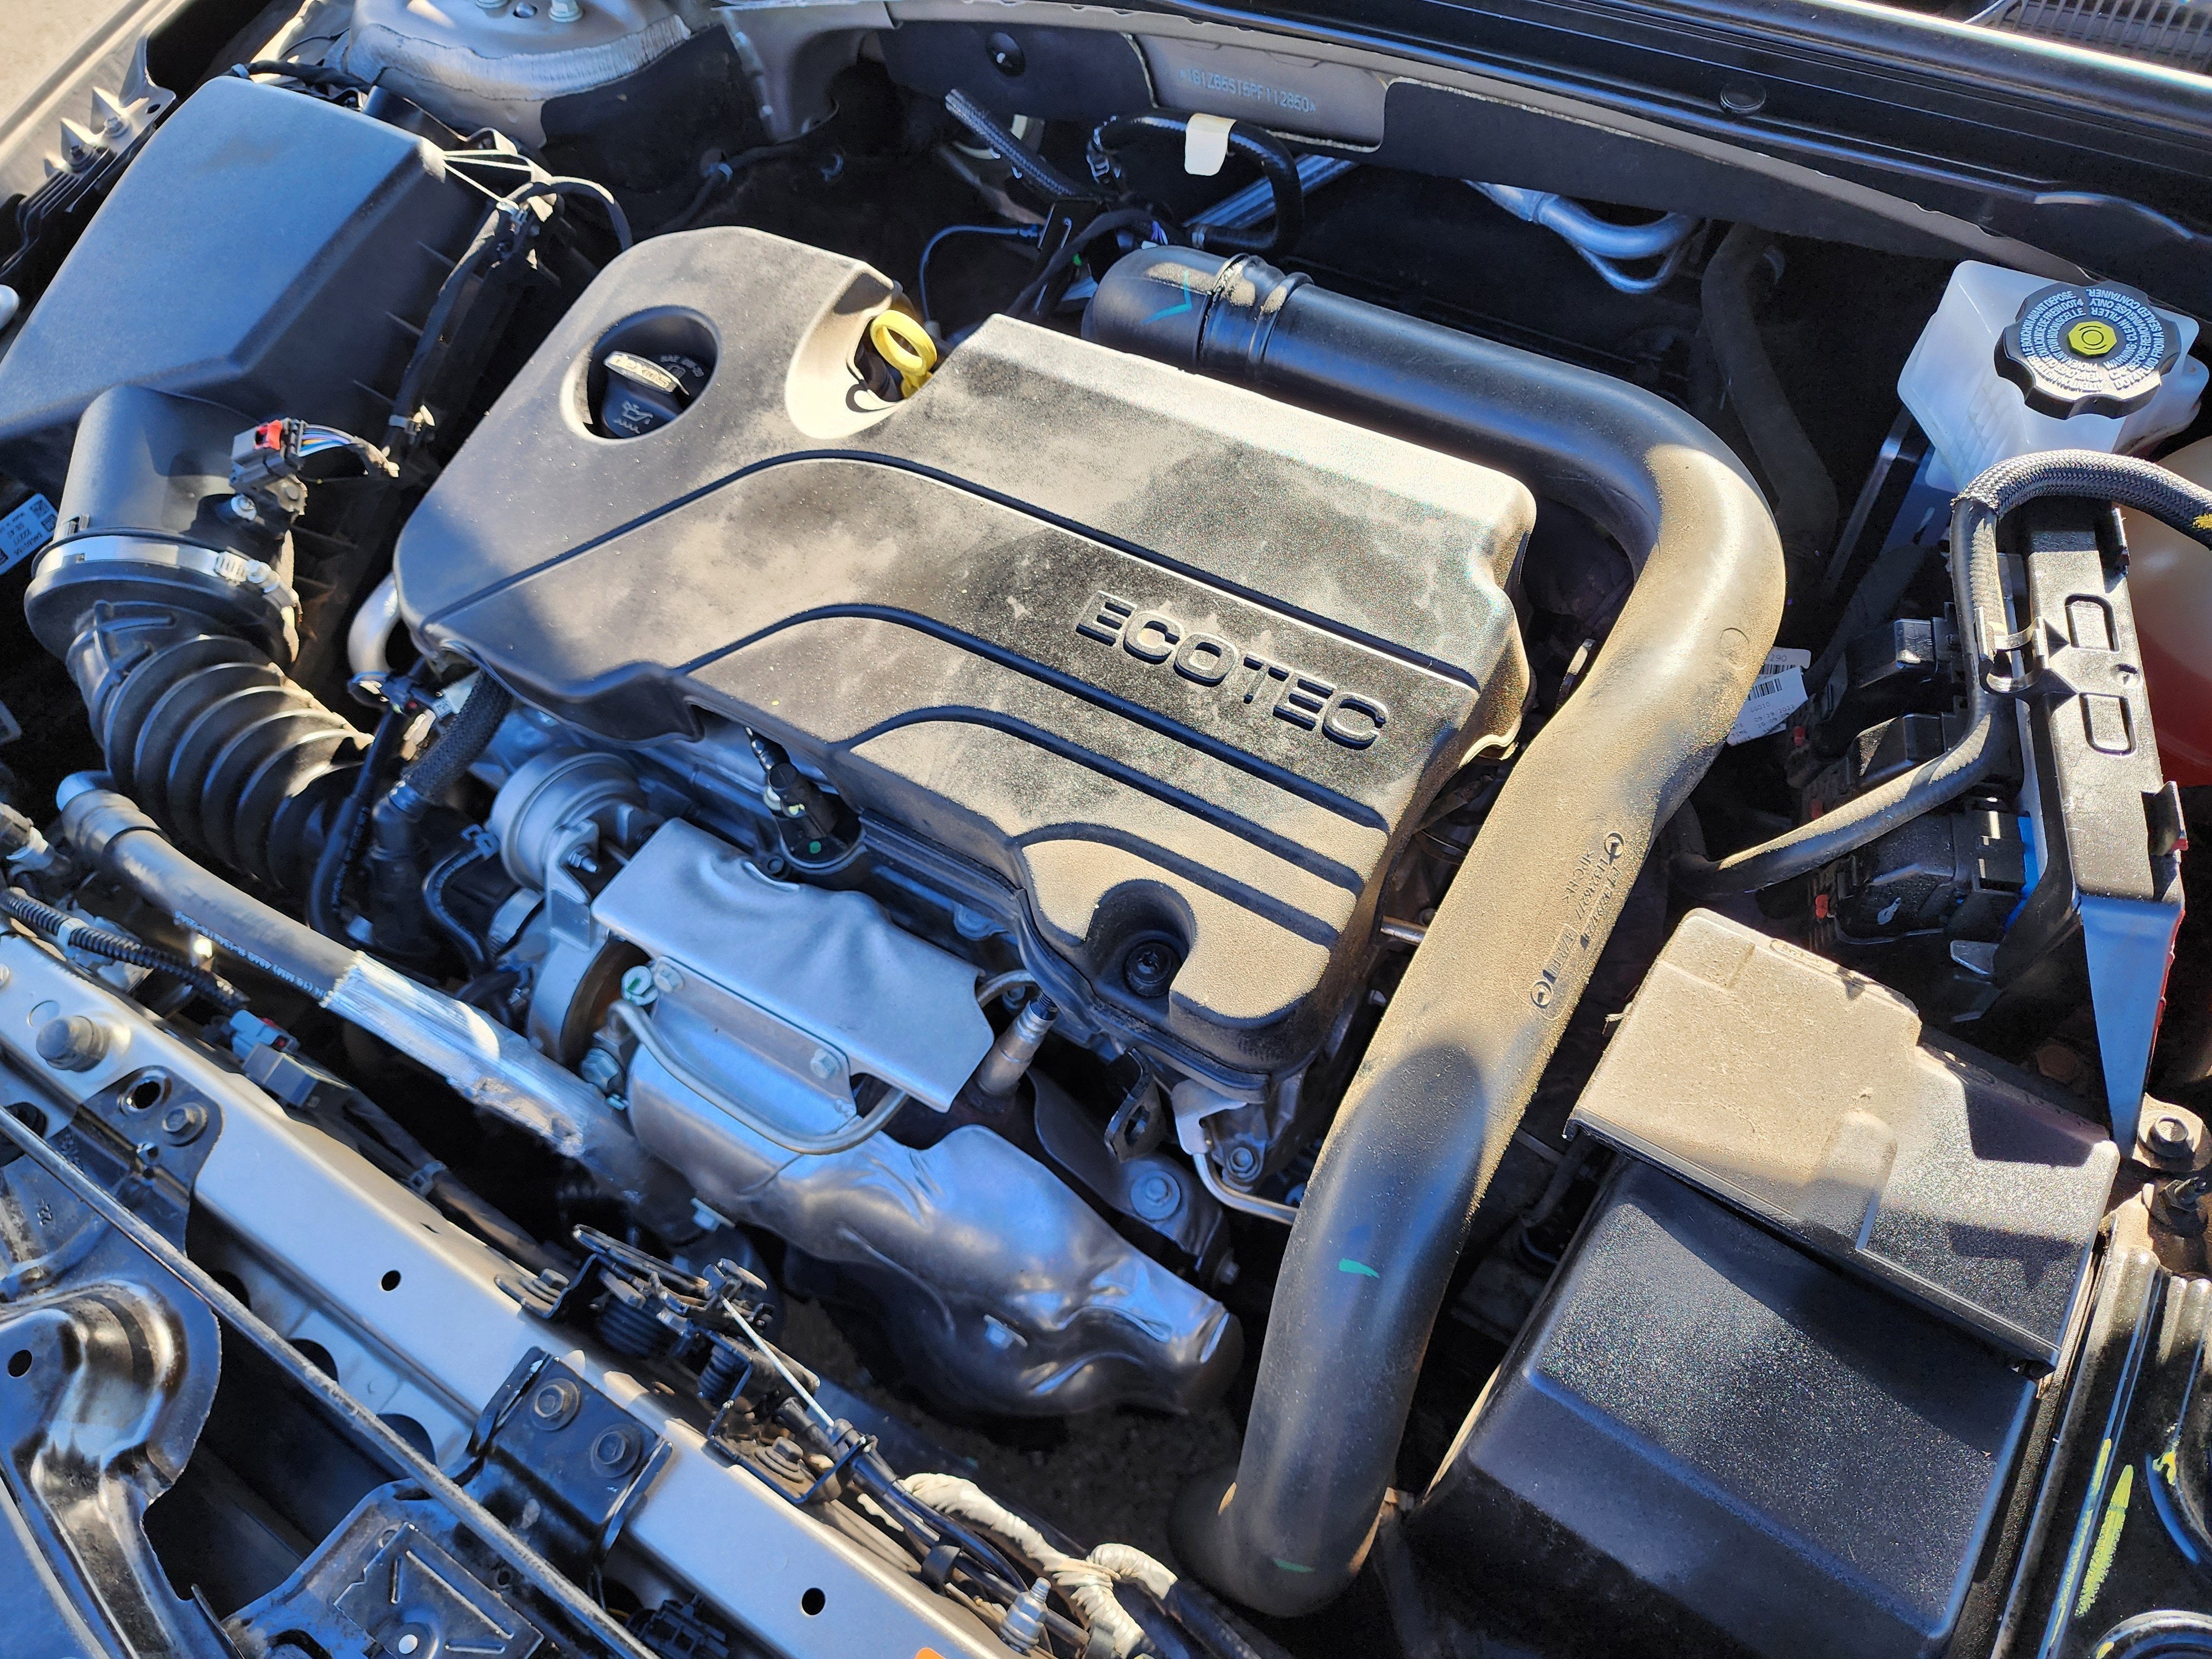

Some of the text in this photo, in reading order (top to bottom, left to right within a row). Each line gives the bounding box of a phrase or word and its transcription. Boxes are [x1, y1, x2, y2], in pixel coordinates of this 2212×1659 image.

[2042, 304, 2064, 321] FREIN
[2087, 298, 2115, 309] ONLY
[2091, 307, 2122, 322] FILLER
[2116, 318, 2137, 341] CLEAN
[2136, 305, 2162, 332] SEALED
[2021, 318, 2034, 347] BOUCHON
[2125, 345, 2149, 372] BEFORE
[2150, 337, 2163, 358] FROM
[609, 354, 671, 388] dexos
[2135, 356, 2159, 378] FLUID
[1075, 590, 1389, 751] ECOTEC
